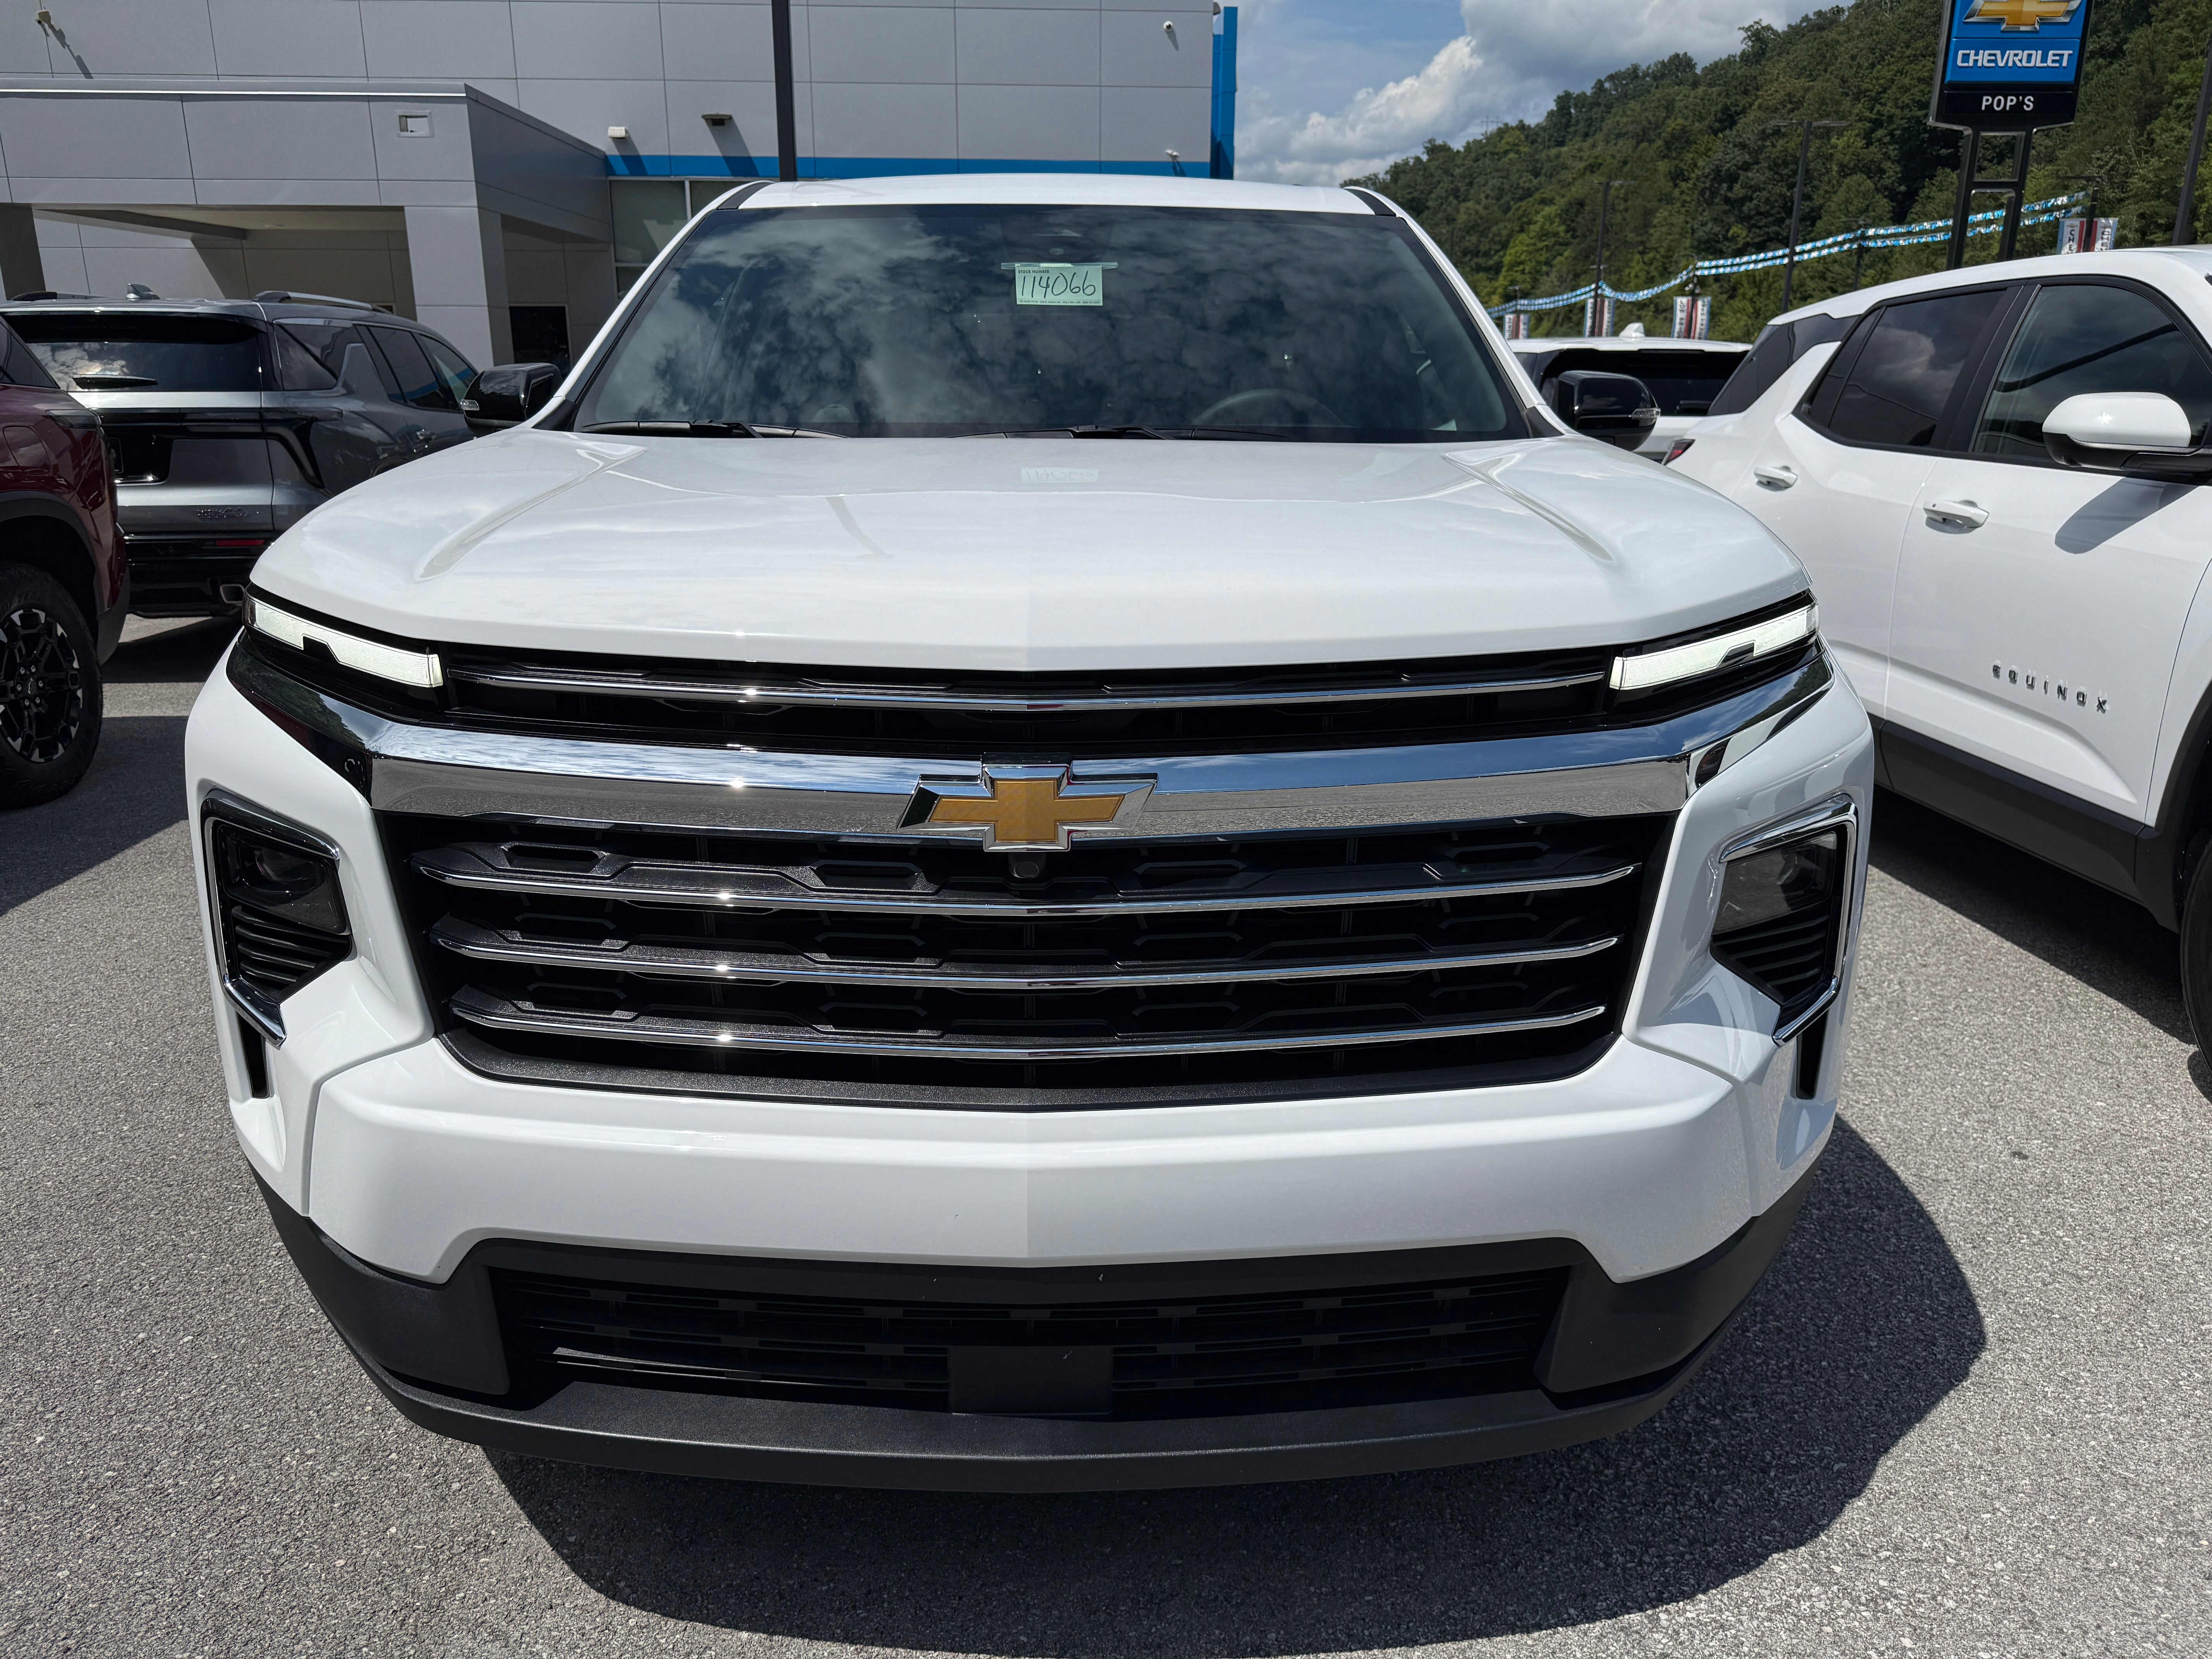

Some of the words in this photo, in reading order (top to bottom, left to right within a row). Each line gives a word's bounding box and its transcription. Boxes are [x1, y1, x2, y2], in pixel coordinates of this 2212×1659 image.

[1957, 50, 2073, 67] CHEVROLET
[1981, 96, 2034, 111] POP'S
[1022, 270, 1096, 299] 114066
[1992, 664, 2107, 713] EQUINOX
